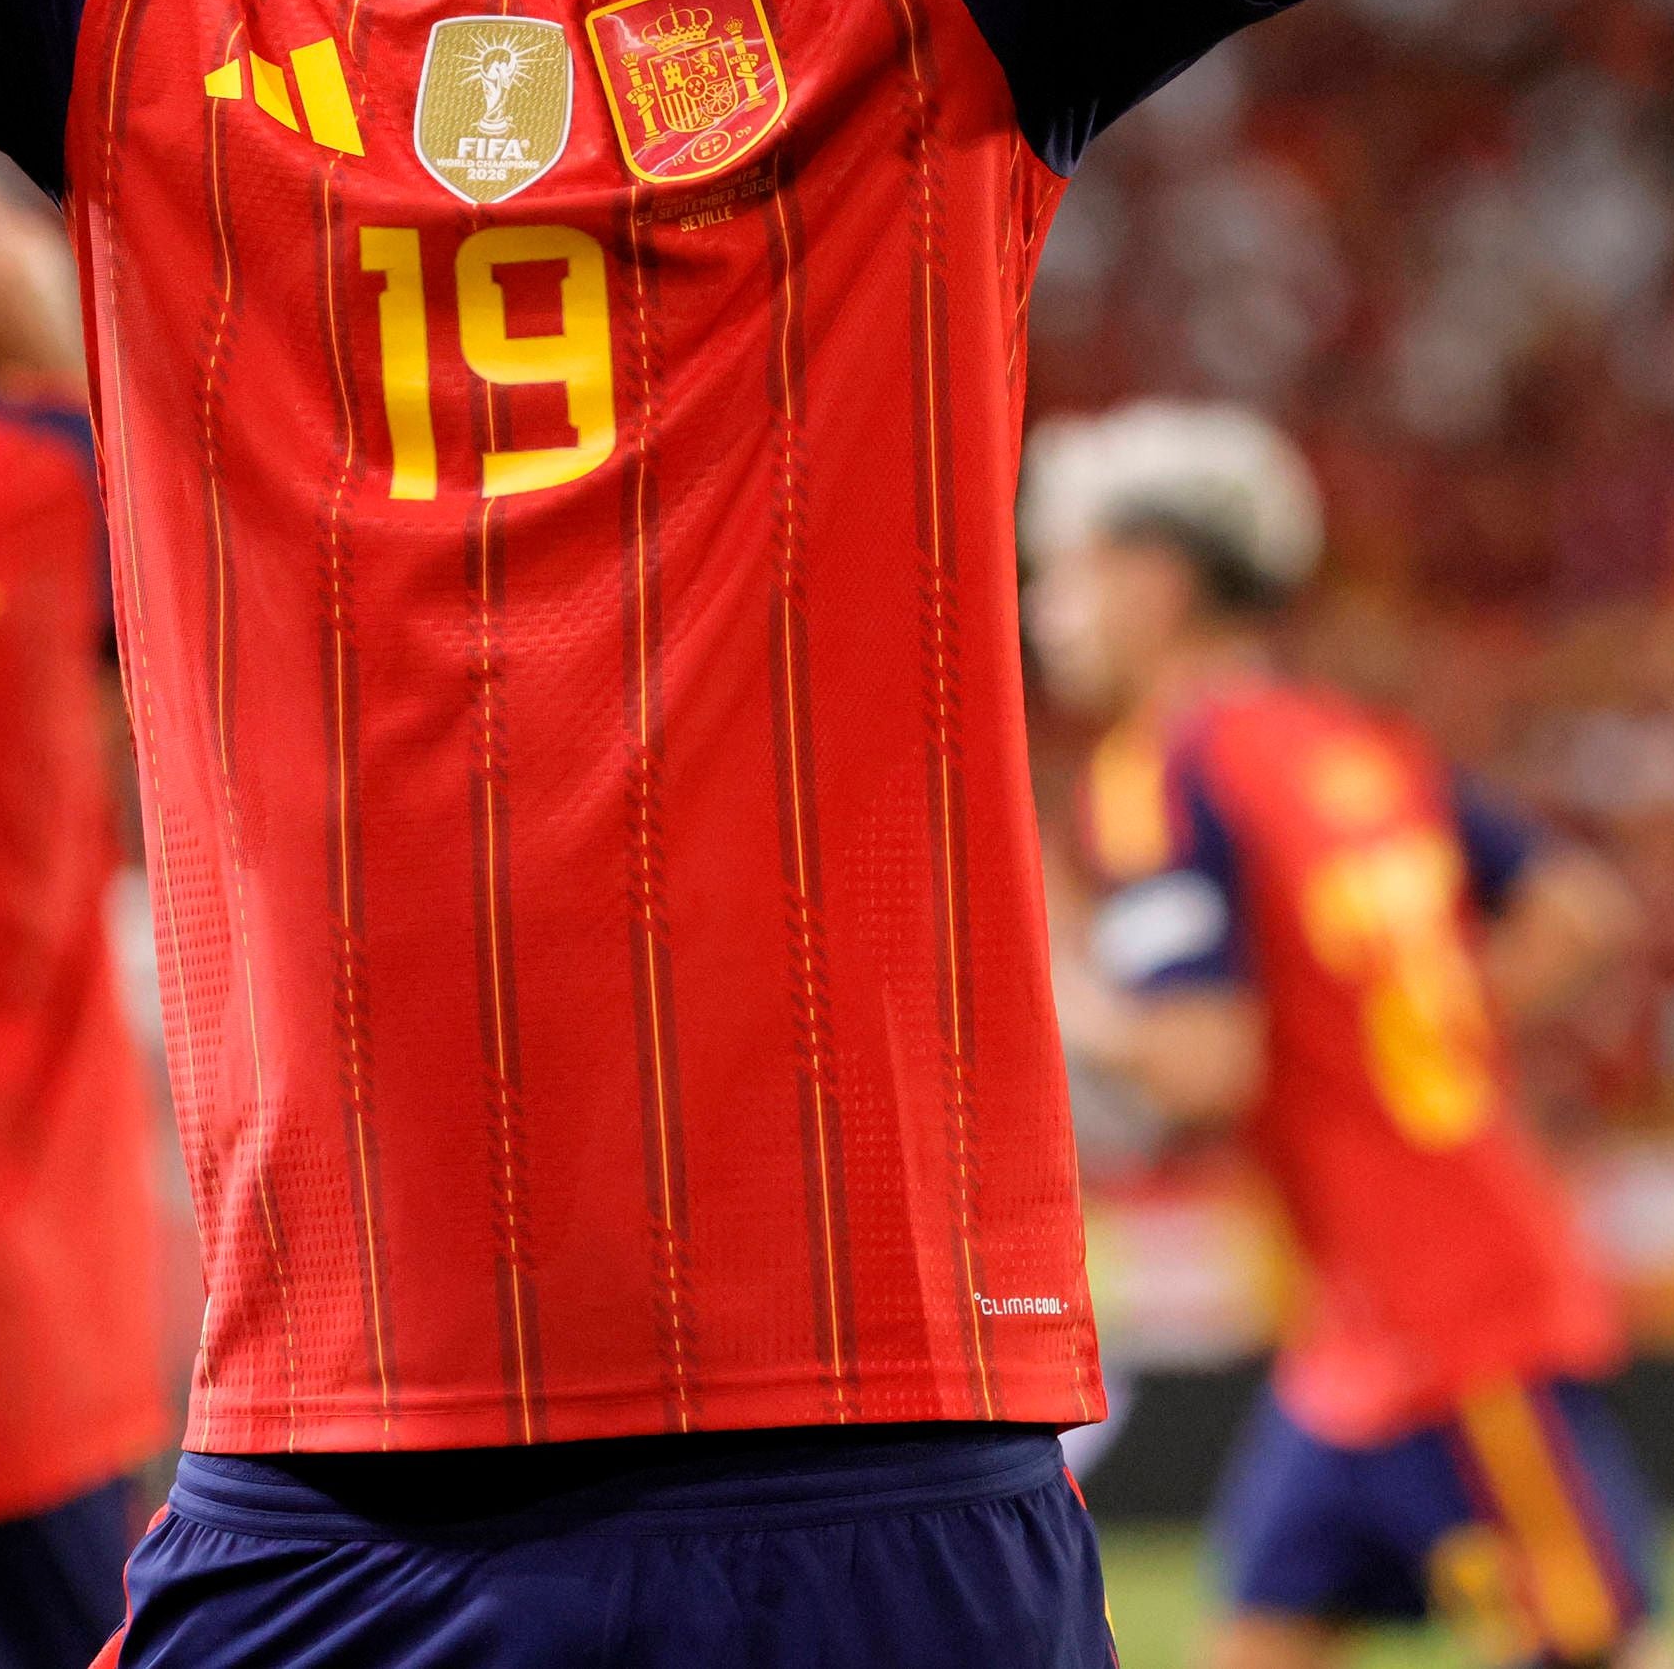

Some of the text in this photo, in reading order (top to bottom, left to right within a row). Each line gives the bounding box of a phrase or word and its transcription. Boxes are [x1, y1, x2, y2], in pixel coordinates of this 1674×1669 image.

[436, 158, 540, 169] WORLD CHAMPIONS
[466, 168, 507, 181] 2026
[658, 188, 736, 220] SEPTEMBER
[679, 205, 734, 233] SEVILLE
[359, 224, 616, 501] 19
